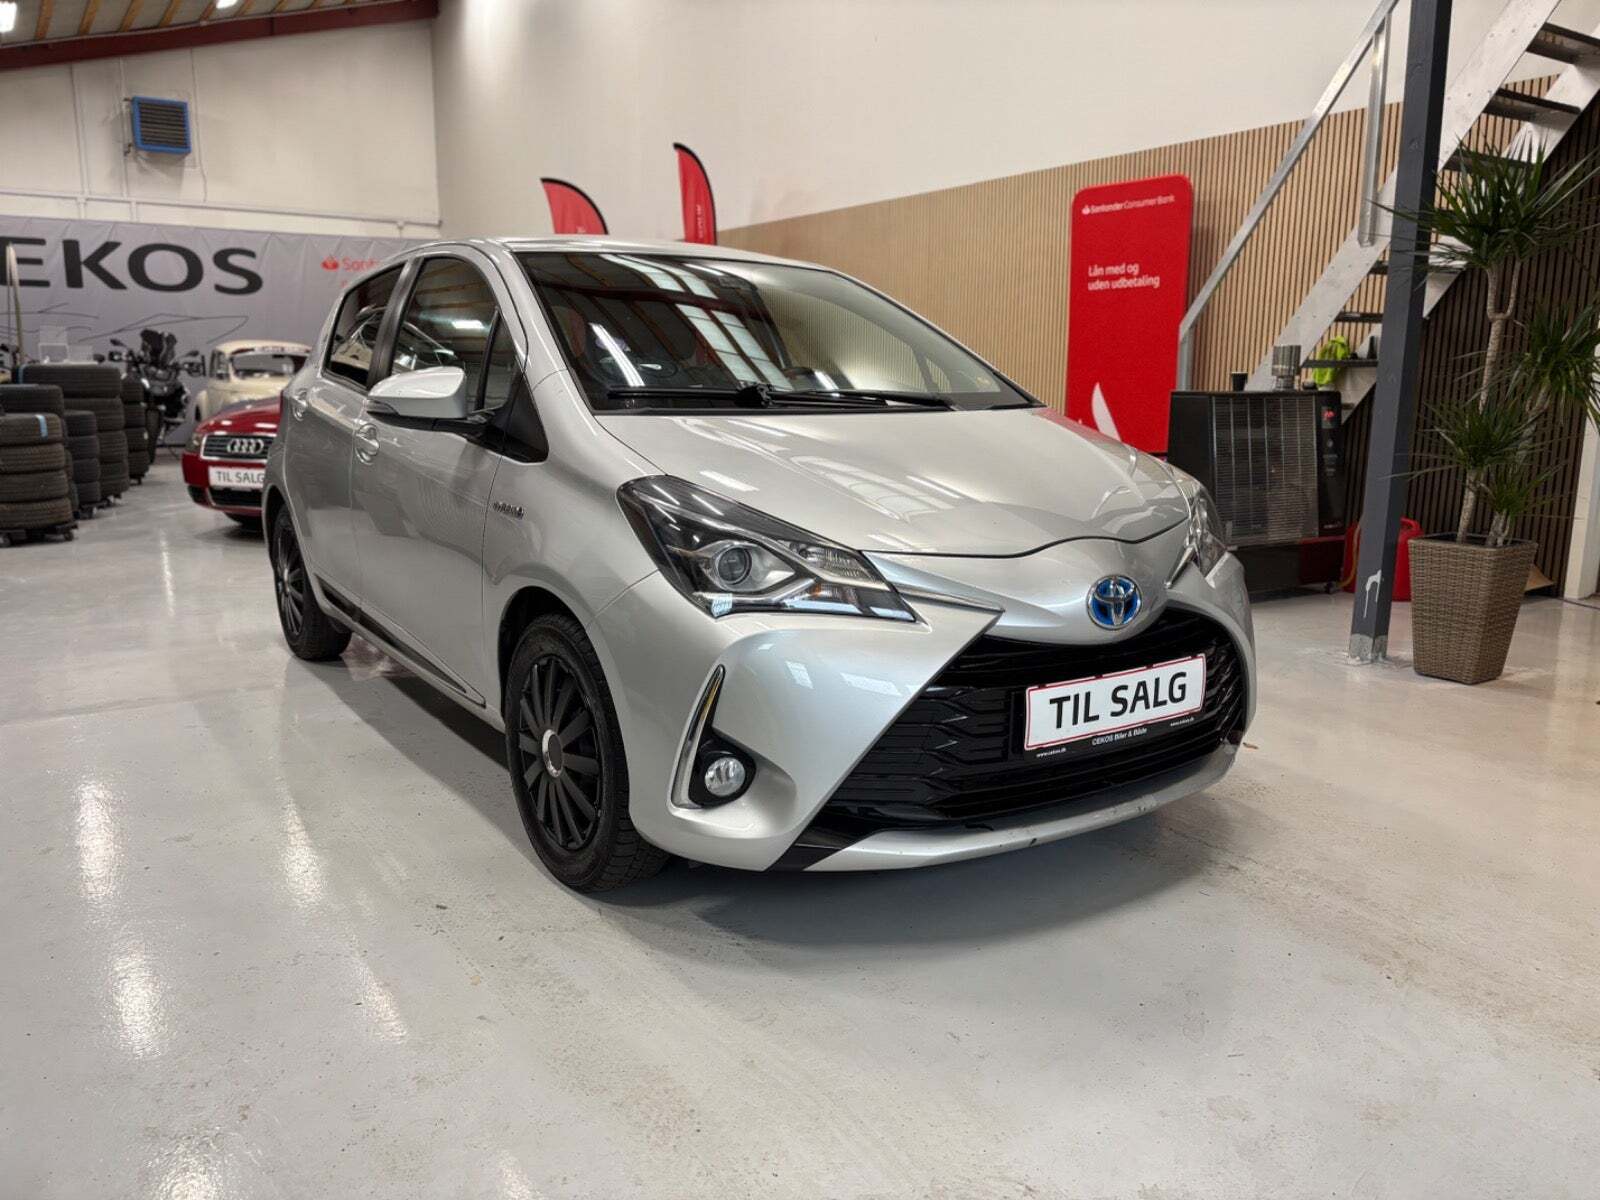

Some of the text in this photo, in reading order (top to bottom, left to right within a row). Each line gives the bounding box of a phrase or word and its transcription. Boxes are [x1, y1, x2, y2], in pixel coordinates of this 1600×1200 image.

[1127, 263, 1139, 276] og
[215, 471, 233, 482] TIL
[1049, 671, 1187, 729] TIL SALG
